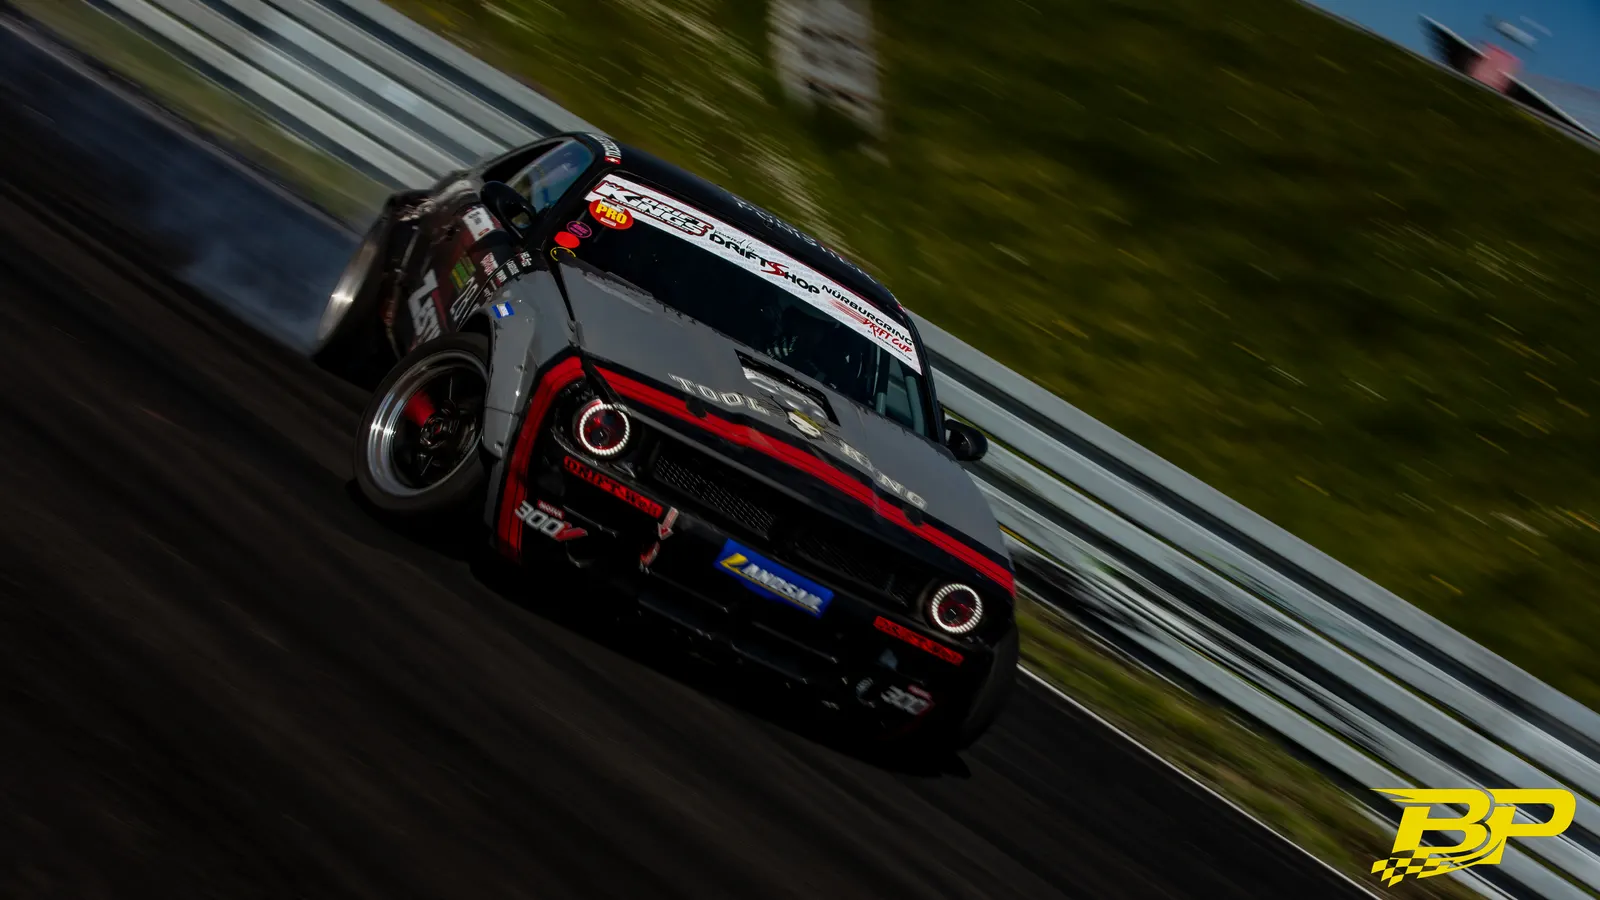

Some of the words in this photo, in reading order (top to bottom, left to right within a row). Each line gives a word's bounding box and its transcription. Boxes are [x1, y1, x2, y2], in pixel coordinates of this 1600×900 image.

[592, 180, 706, 237] KINGS
[595, 203, 628, 224] PRO
[821, 284, 913, 346] NÜRBURGRING
[862, 318, 893, 339] DRIFT
[891, 338, 912, 353] CUP
[514, 500, 588, 543] 300V
